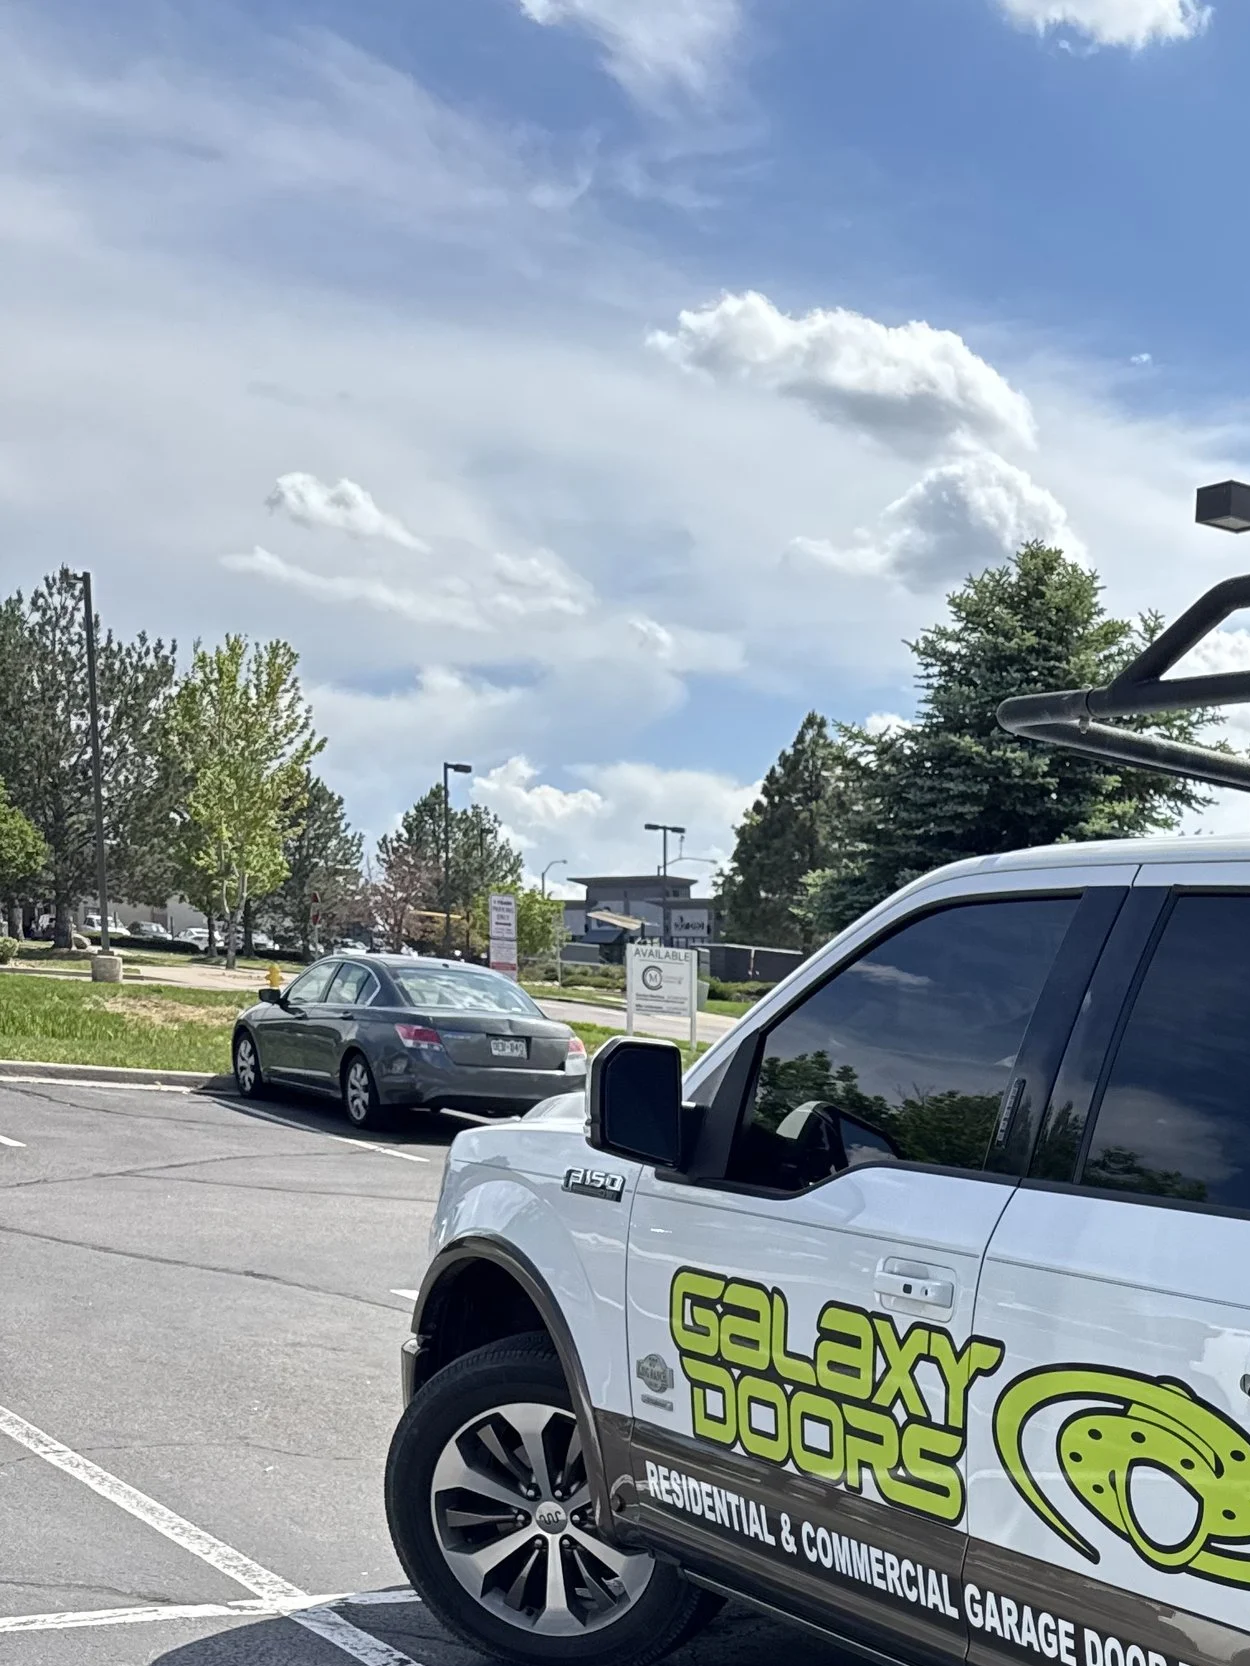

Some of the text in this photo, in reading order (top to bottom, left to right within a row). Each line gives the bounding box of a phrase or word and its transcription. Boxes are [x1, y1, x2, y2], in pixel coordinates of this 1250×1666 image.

[634, 948, 691, 962] AVAILABLE
[680, 1350, 966, 1527] DOORS
[645, 1460, 776, 1547] RESIDENTIAL
[780, 1512, 797, 1555] &
[801, 1521, 960, 1620] COMMERCIAL
